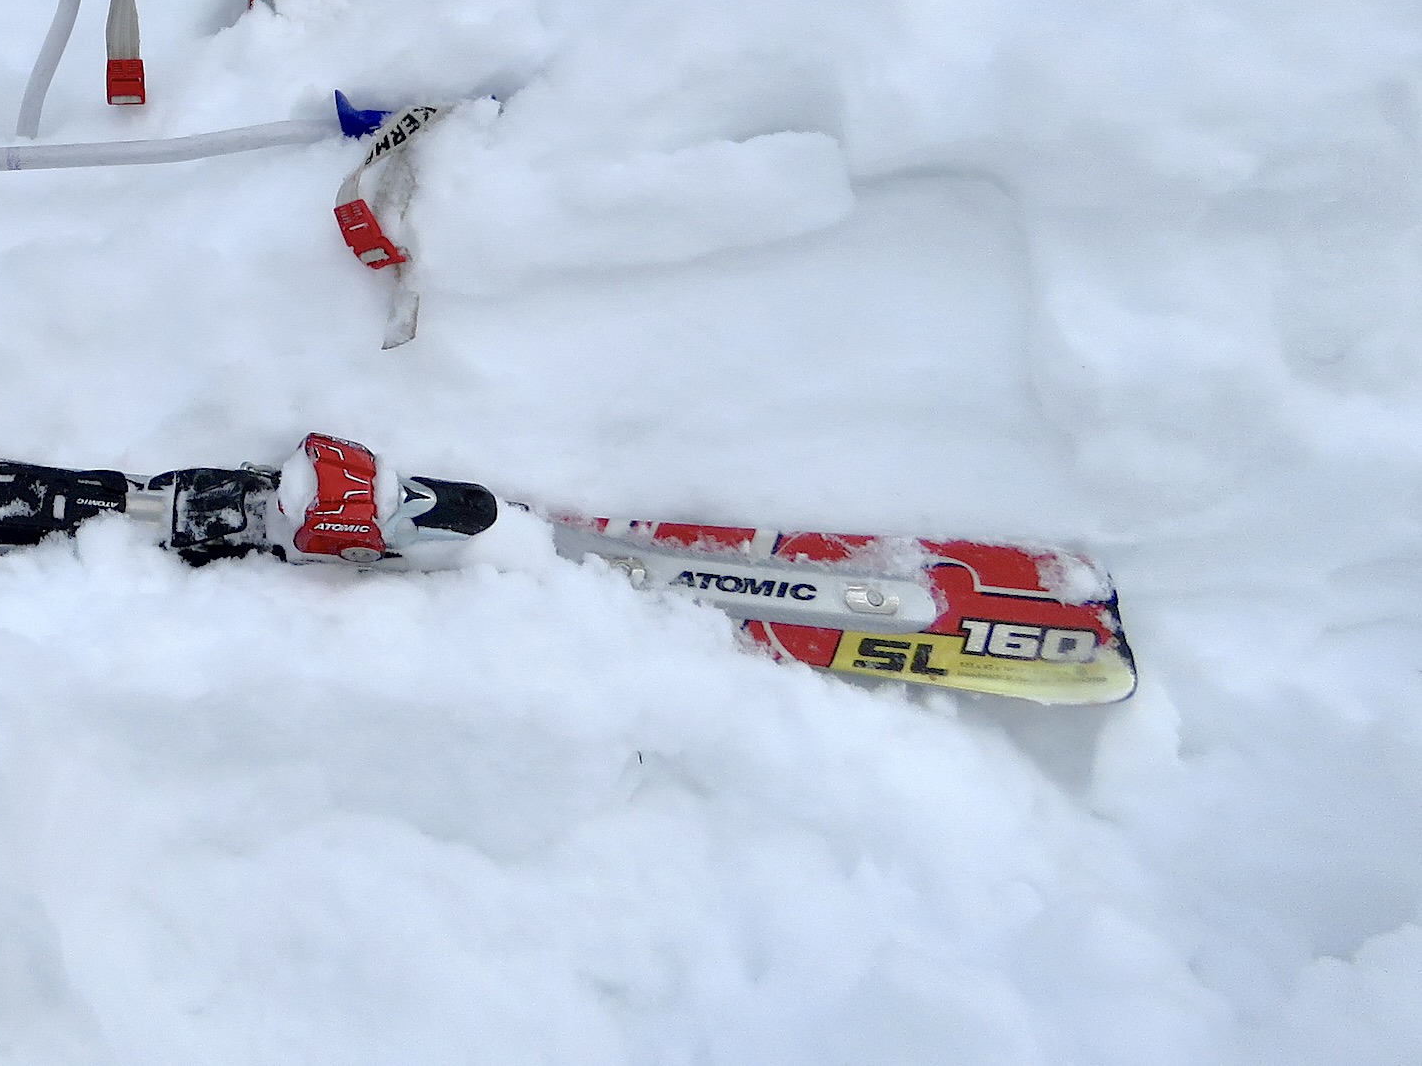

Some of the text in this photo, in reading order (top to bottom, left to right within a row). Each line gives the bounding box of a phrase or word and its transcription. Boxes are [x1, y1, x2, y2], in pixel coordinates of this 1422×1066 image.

[76, 497, 119, 508] ATOMIC
[314, 522, 370, 533] ATOMIC
[669, 570, 816, 601] ATOMIC
[853, 618, 1096, 678] SL 160
